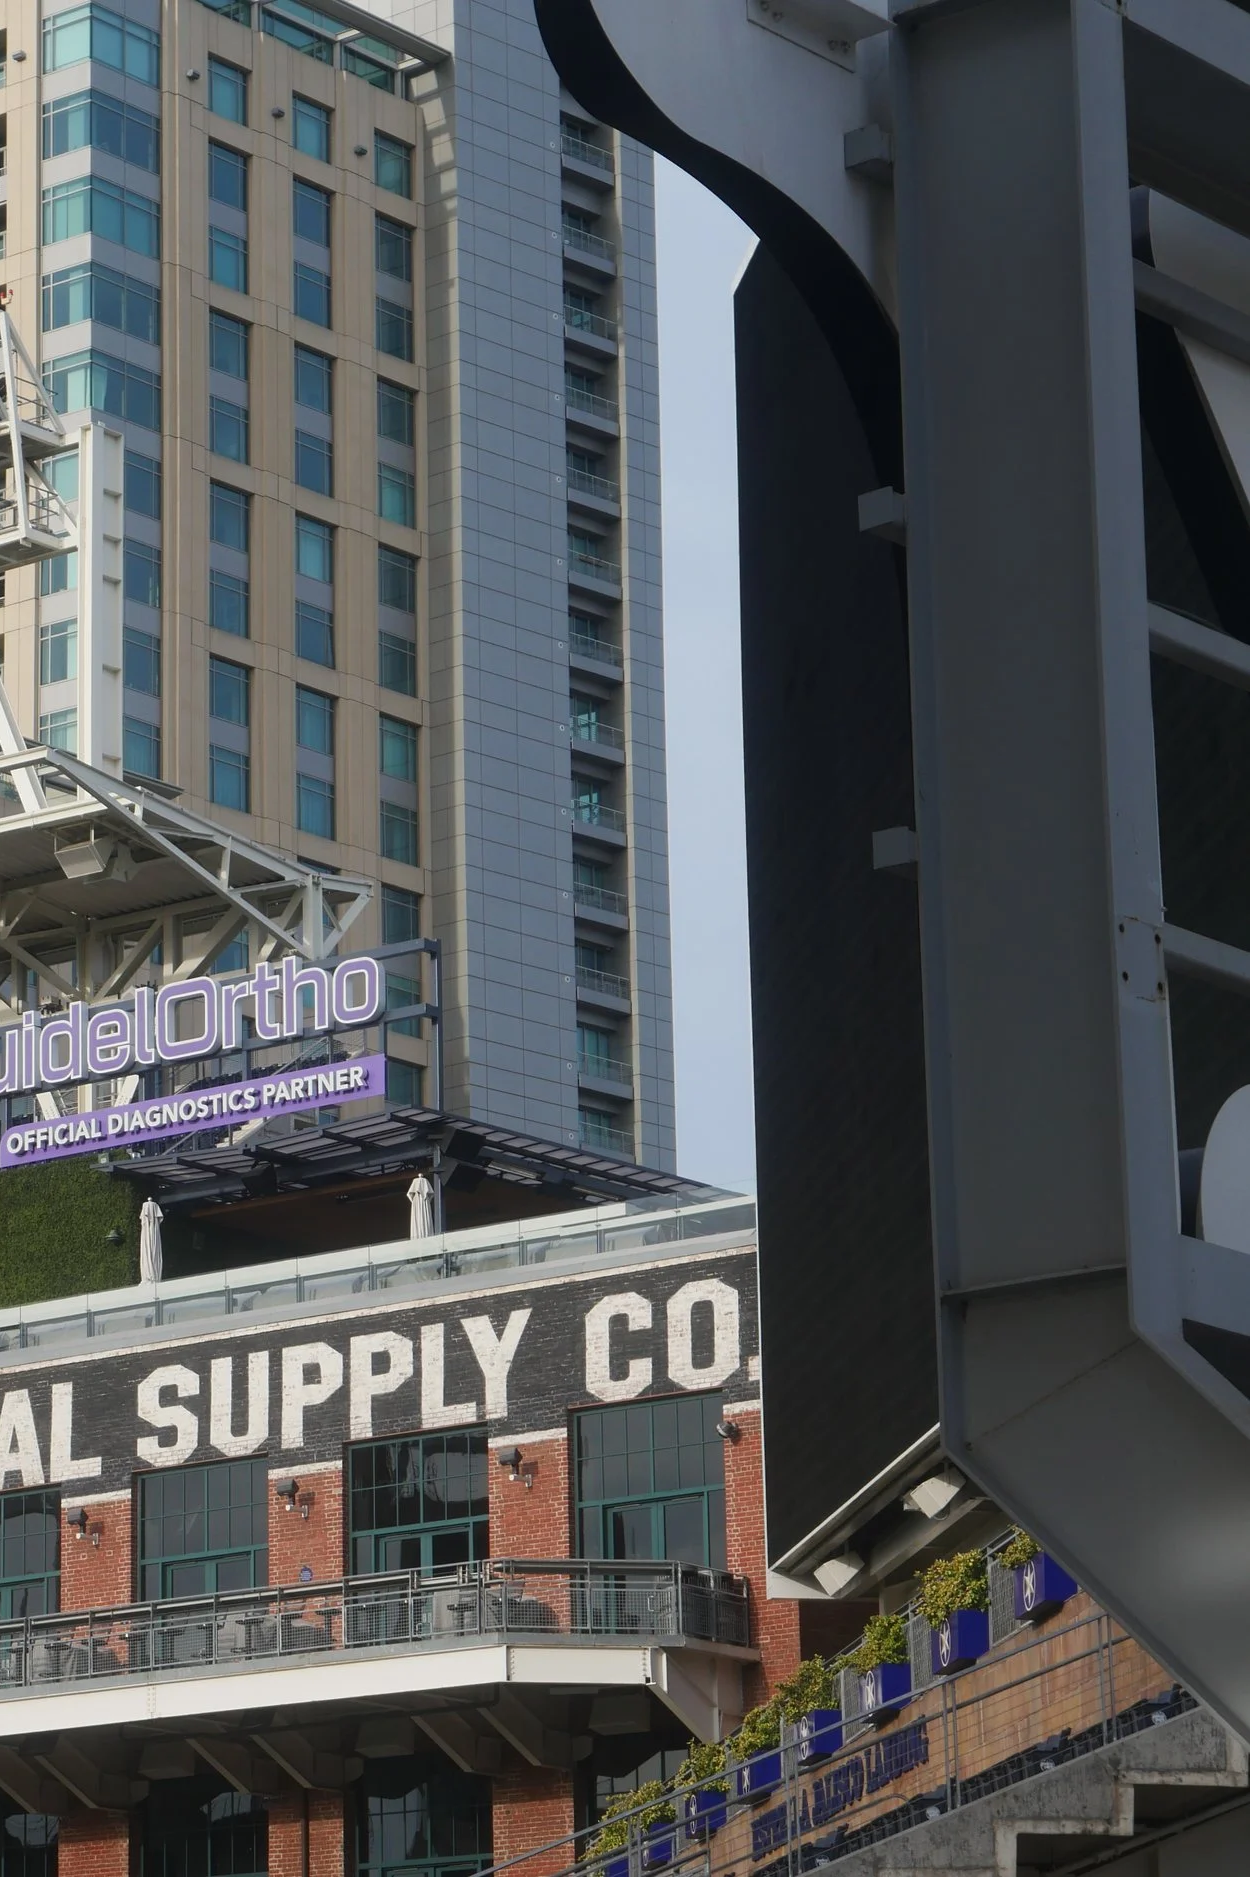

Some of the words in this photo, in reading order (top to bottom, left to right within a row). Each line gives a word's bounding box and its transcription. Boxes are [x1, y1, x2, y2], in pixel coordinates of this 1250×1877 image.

[6, 1117, 104, 1156] OFFICIAL
[107, 1087, 257, 1135] DIAGNOSTICS
[262, 1066, 368, 1106] PARTNER
[136, 1308, 532, 1465] SUPPLY
